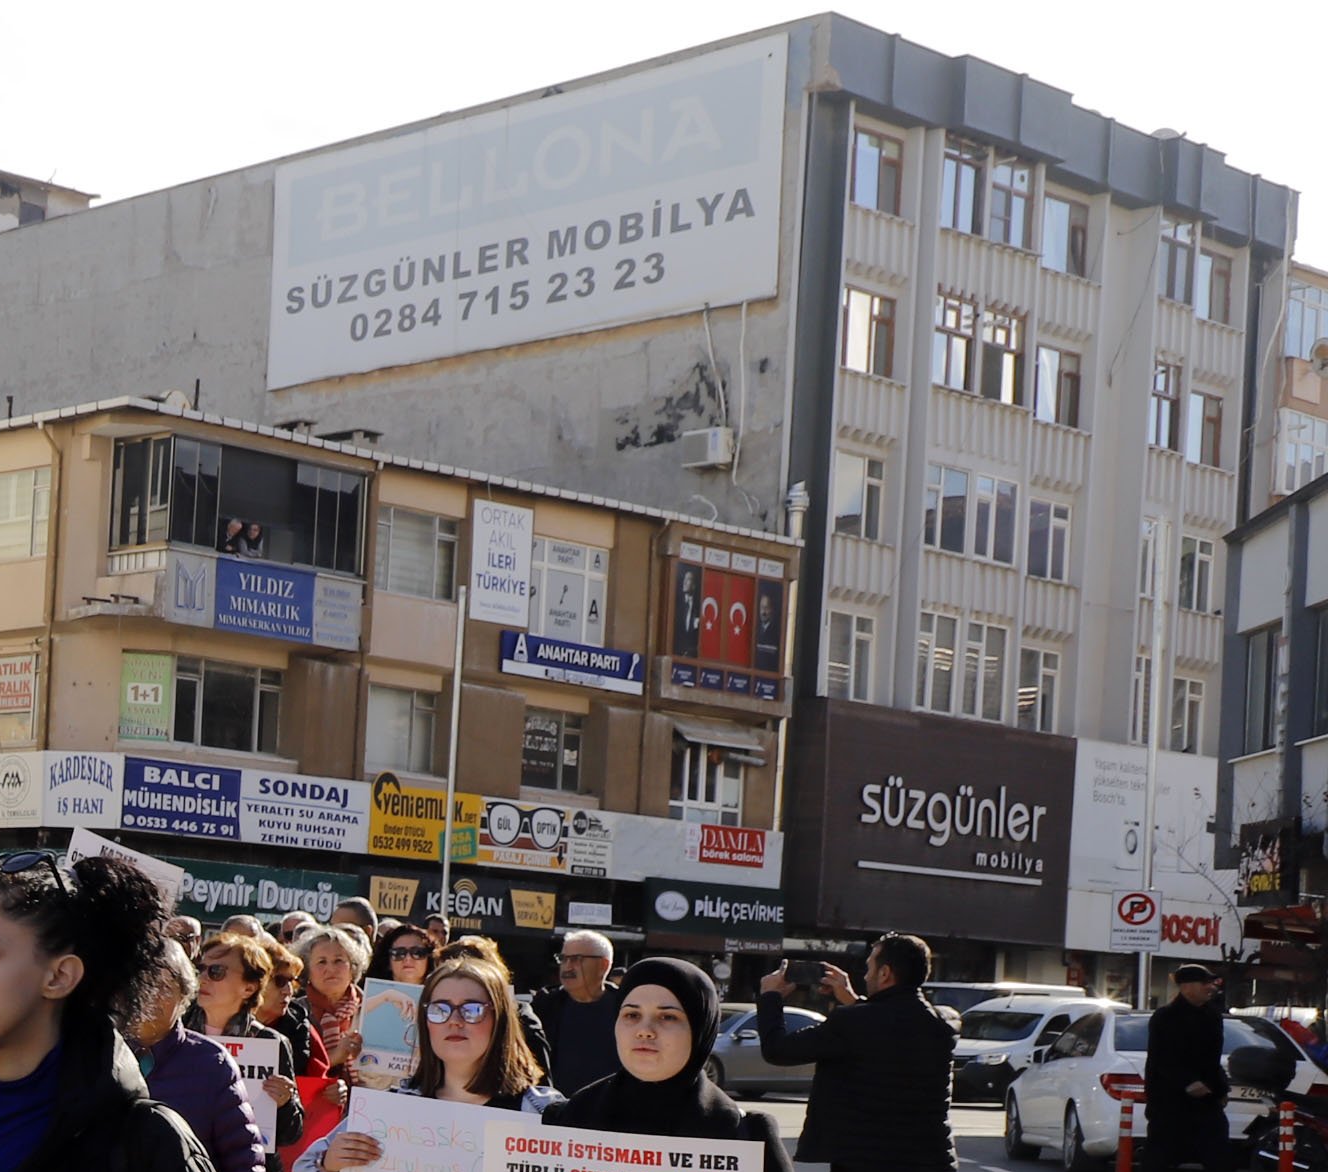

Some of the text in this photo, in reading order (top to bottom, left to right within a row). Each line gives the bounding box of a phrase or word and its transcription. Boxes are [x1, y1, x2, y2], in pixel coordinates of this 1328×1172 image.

[314, 96, 723, 242] BELLONA
[285, 187, 756, 315] SÜZGÜNLER MOBİLYA
[349, 251, 666, 342] 0284 715 23 23
[480, 506, 526, 531] ORTAK
[488, 529, 516, 550] AKIL
[487, 547, 517, 572] İLERİ
[239, 572, 295, 600] YILDIZ
[475, 570, 527, 597] TÜRKİYE
[537, 643, 621, 672] ANAHTAR PARTİ
[129, 684, 161, 703] 1+1
[48, 754, 114, 793] KARDEŞLER
[143, 765, 221, 791] BALCI
[56, 796, 69, 816] İŞ
[72, 797, 105, 815] HANI
[123, 788, 239, 818] MÜHENDİSLİK
[258, 777, 350, 809] SONDAJ
[246, 802, 360, 826] YERALTI SU ARAMA
[860, 774, 1048, 848] süzgünler
[136, 815, 234, 837] 0533 446 75 91
[258, 819, 292, 833] KUYU
[497, 815, 512, 831] GÜL
[536, 820, 558, 836] OPTİK
[260, 831, 343, 850] ZEMİN ETÜDÜ
[373, 835, 395, 849] 0532
[395, 838, 412, 852] 499
[413, 840, 433, 854] 9522
[702, 827, 764, 853] DAMLA
[702, 848, 764, 864] börek salonu
[975, 850, 1044, 876] mobilya
[180, 872, 255, 913] Peynir
[377, 891, 409, 912] Kılıf
[694, 895, 731, 924] PİLİÇ
[731, 899, 785, 925] ÇEVİRME
[1160, 913, 1222, 947] BOSCH
[504, 1136, 740, 1171] ÇOCUK İSTİSMARI VE HER
